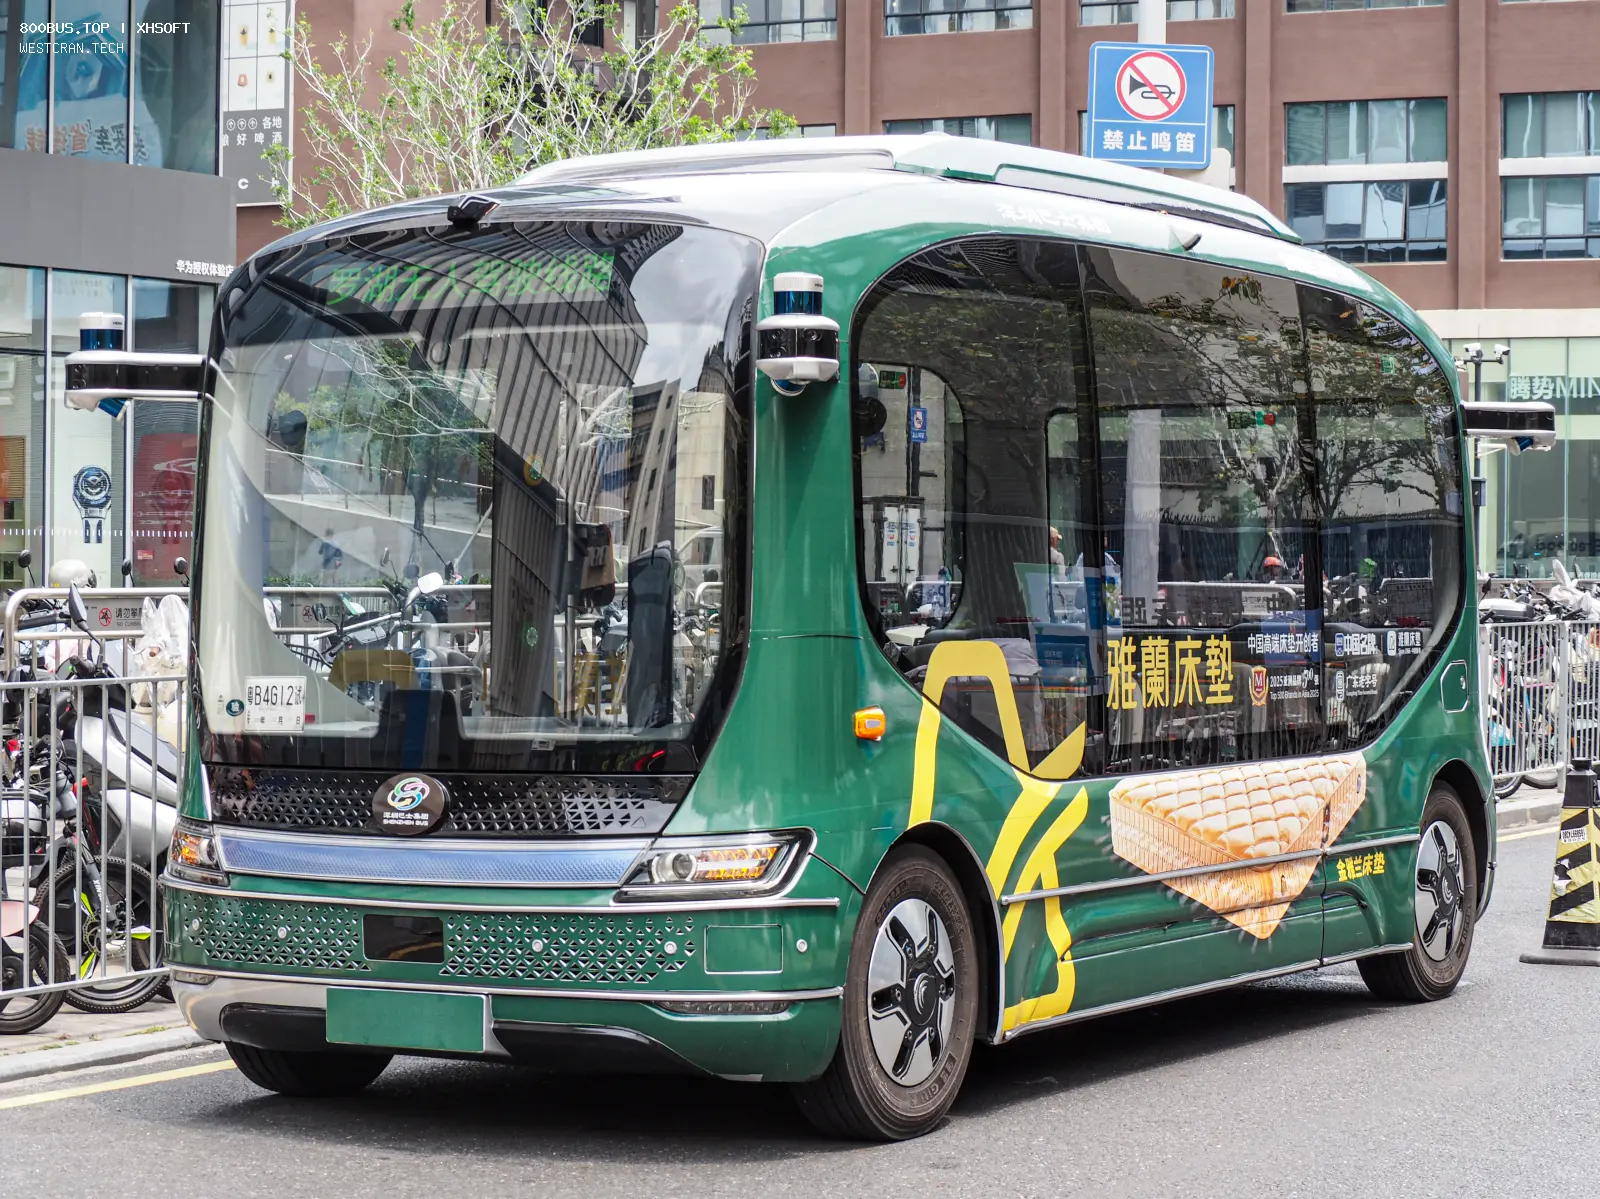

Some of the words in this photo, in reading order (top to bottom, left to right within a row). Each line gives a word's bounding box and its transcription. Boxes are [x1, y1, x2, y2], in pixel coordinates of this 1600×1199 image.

[262, 116, 283, 129] 各地
[1102, 129, 1196, 153] 禁止鸣笛
[1247, 632, 1319, 655] 中国高端床垫开创者
[1106, 634, 1234, 710] 雅蘭床墊
